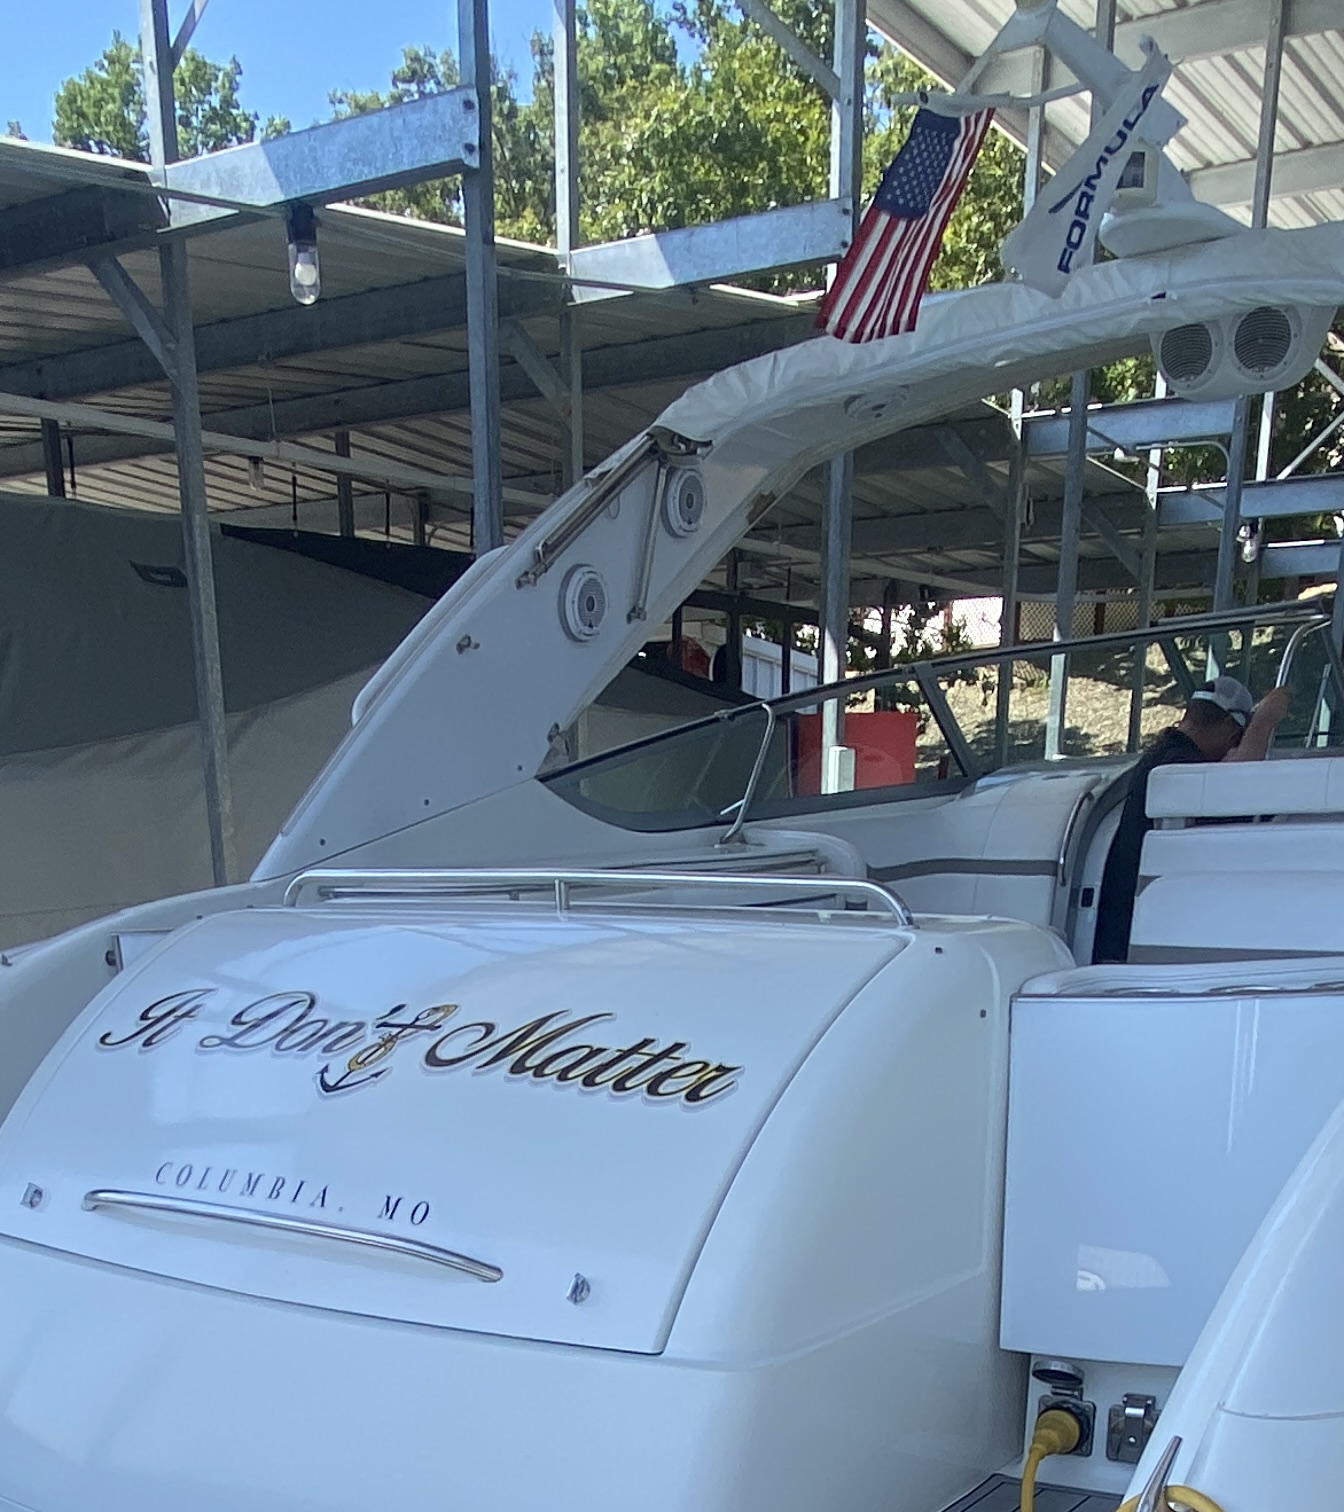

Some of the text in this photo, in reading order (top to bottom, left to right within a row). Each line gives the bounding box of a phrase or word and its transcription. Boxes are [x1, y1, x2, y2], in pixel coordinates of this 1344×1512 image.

[1057, 84, 1159, 274] FORMULA
[99, 988, 217, 1049] It
[423, 1000, 743, 1104] Matter
[377, 1194, 430, 1226] MO
